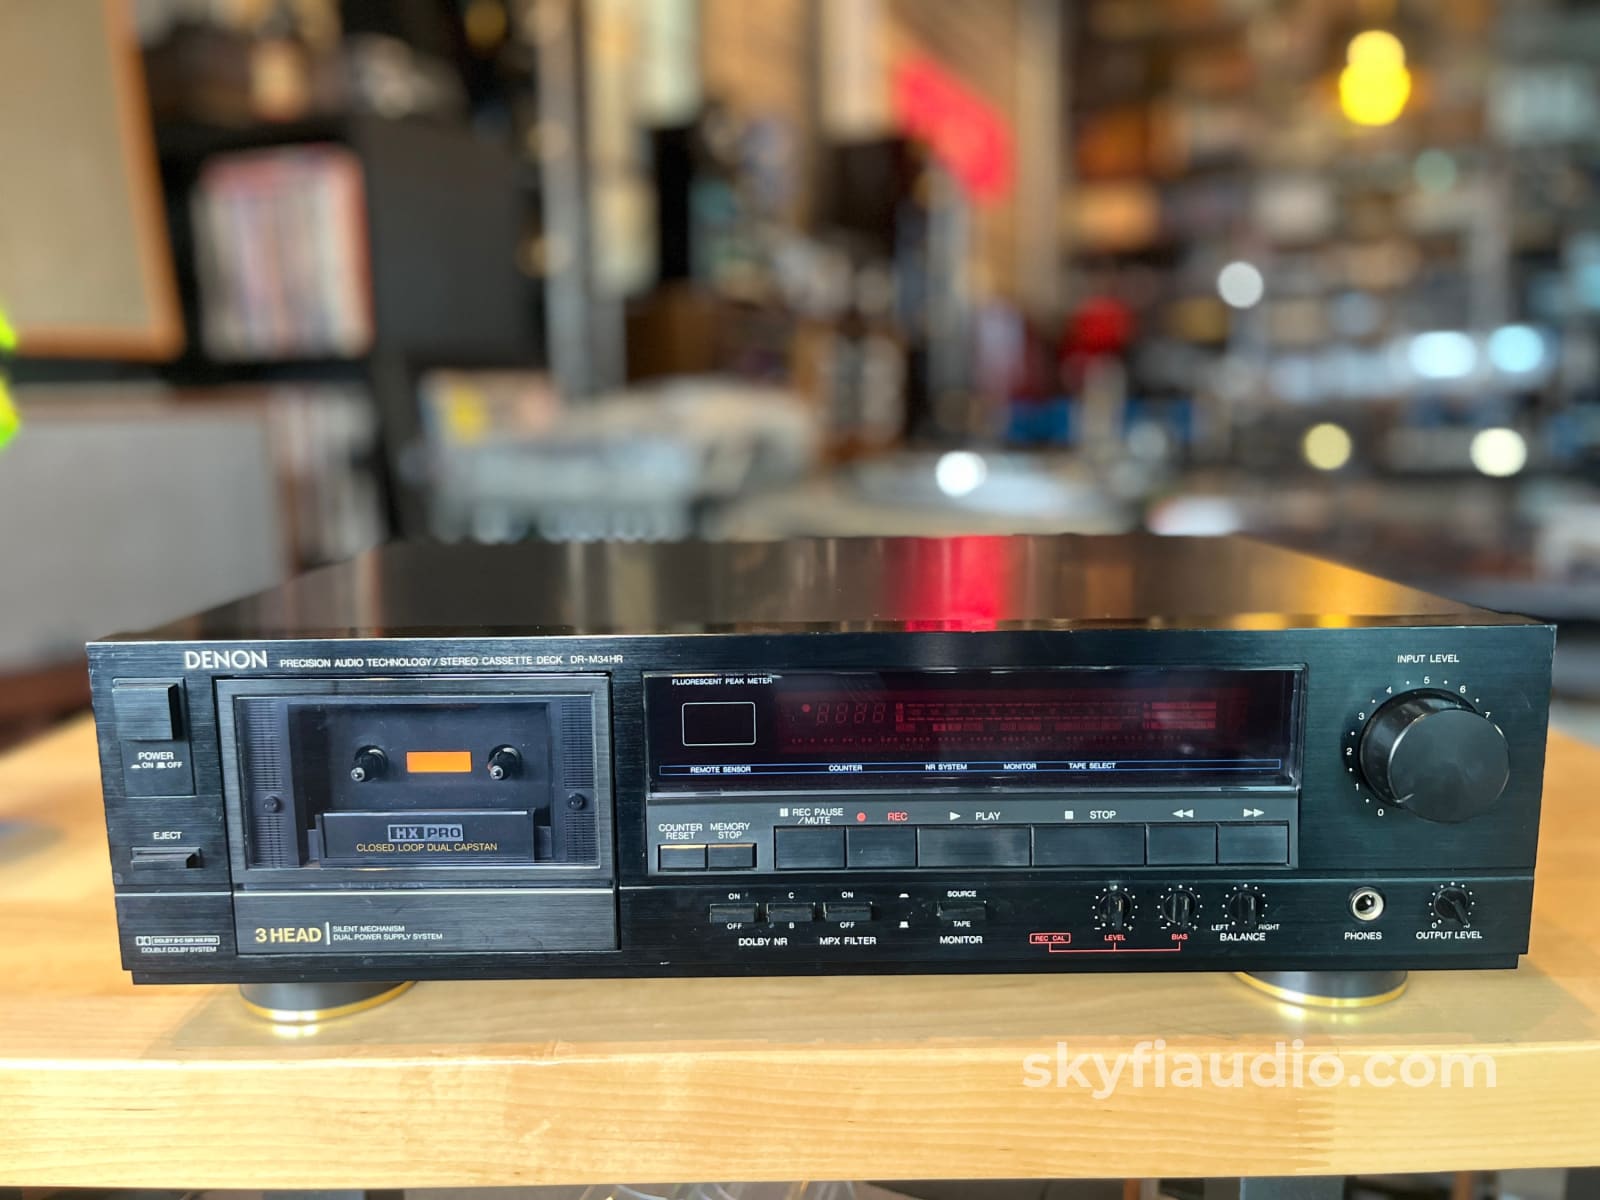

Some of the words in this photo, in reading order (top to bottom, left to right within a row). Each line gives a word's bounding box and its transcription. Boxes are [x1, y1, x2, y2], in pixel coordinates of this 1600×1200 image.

[184, 650, 268, 669] DENON
[279, 659, 332, 668] PRECISION
[334, 658, 364, 667] AUDIO
[482, 656, 533, 665] CASSETTE
[536, 655, 562, 665] DECK
[570, 654, 623, 664] DR-M34HR
[1397, 655, 1425, 663] INPUT
[1429, 654, 1460, 663] LEVEL
[672, 678, 722, 686] FLUORESCENT
[725, 677, 744, 685] PEAK
[1424, 676, 1430, 684] 5
[1386, 686, 1392, 694] 4
[1459, 685, 1466, 693] 6
[1358, 712, 1365, 720] 3
[1485, 711, 1491, 719] 7
[138, 751, 174, 761] POWER
[1346, 747, 1352, 756] 2
[141, 761, 154, 769] ON
[828, 764, 862, 772] COUNTER
[690, 766, 720, 774] REMOTE
[1355, 783, 1359, 791] 1
[792, 808, 812, 817] REC
[814, 807, 844, 816] PAUSE
[887, 812, 908, 821] REC
[975, 811, 1001, 821] PLAY
[1089, 810, 1116, 820] STOP
[1377, 808, 1384, 816] 0
[797, 816, 831, 825] /MUTE
[658, 823, 703, 832] COUNTER
[709, 822, 750, 831] MEMORY
[153, 831, 182, 840] EJECT
[395, 826, 418, 839] HX
[426, 826, 461, 839] PRO
[666, 831, 696, 840] RESET
[718, 831, 742, 839] STOP
[356, 843, 395, 852] CLOSED
[398, 843, 425, 852] LOOP
[427, 843, 452, 851] DUAL
[454, 842, 497, 851] CAPSTAN
[841, 891, 854, 899] ON
[332, 925, 358, 934] SILENT
[726, 922, 742, 930] OFF
[840, 921, 855, 929] OFF
[1258, 923, 1280, 931] RIGHT
[255, 928, 267, 943] 3
[270, 927, 322, 943] HEAD
[333, 933, 353, 941] DUAL
[354, 933, 381, 941] POWER
[383, 933, 412, 941] SUPPLY
[412, 932, 443, 940] SYSTEM
[939, 935, 983, 944] MONITOR
[1219, 932, 1266, 941] BALANCE
[1344, 931, 1382, 941] PHONES
[1415, 931, 1452, 940] OUTPUT
[1454, 931, 1482, 939] LEVEL
[738, 938, 770, 946] DOLBY
[774, 938, 788, 946] NR
[819, 937, 840, 945] MPX
[844, 936, 877, 945] FILTER
